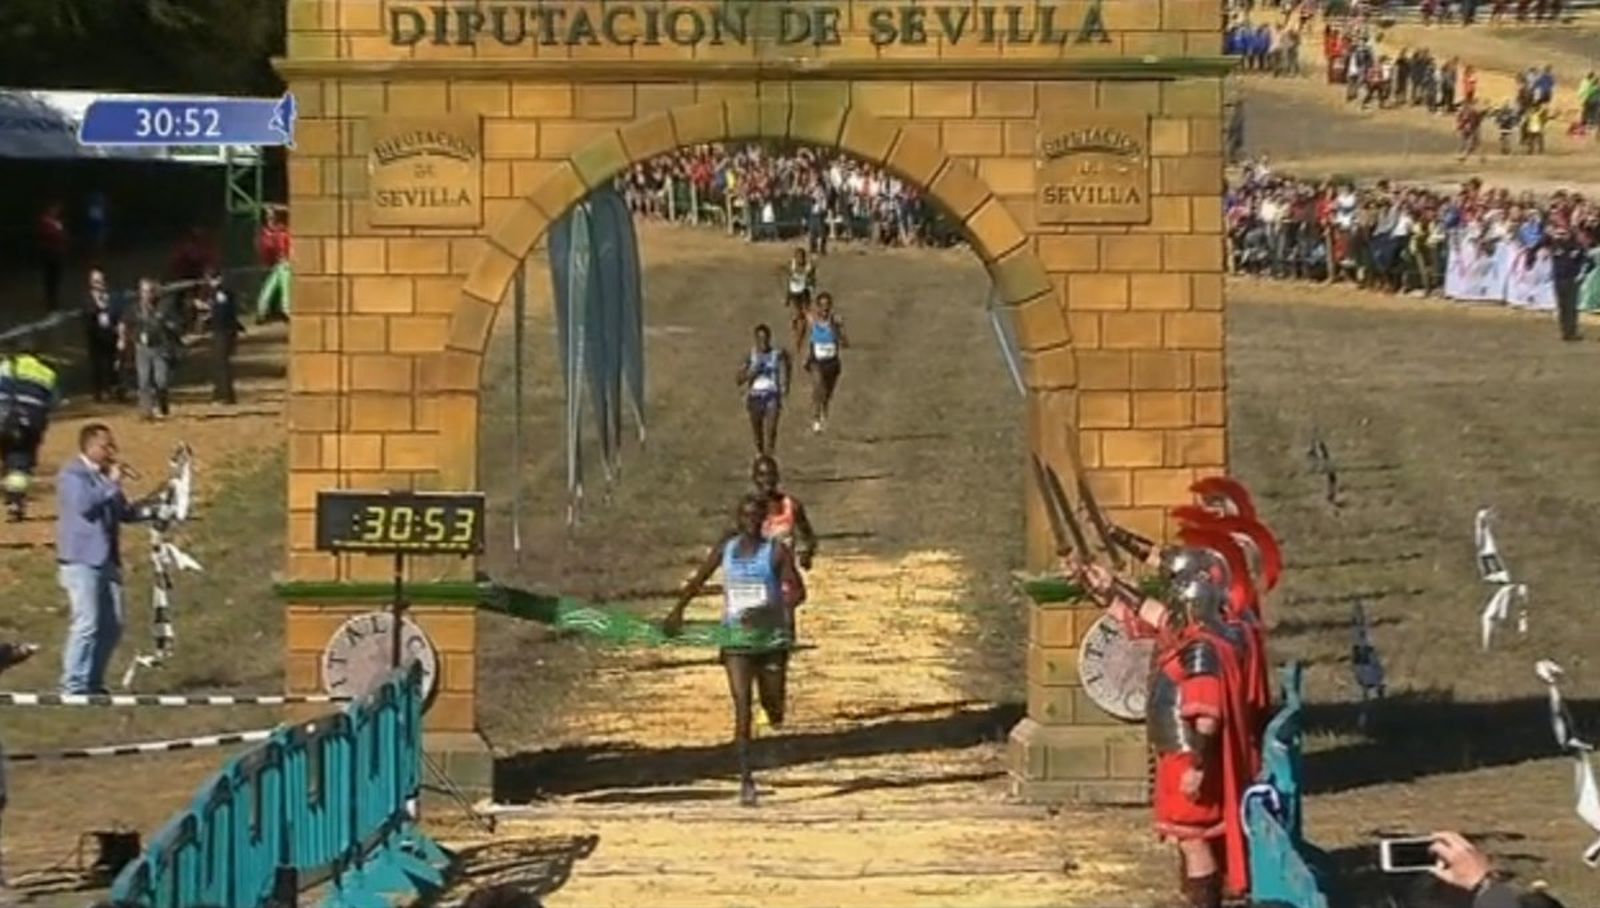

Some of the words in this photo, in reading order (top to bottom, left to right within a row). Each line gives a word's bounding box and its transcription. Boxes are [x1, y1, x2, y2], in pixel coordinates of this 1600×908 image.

[389, 6, 750, 46] DIPUTACION
[776, 7, 842, 45] DE
[869, 5, 1112, 46] SEVILLA
[377, 188, 472, 208] SEVILLA
[1043, 186, 1141, 205] SEVILLA
